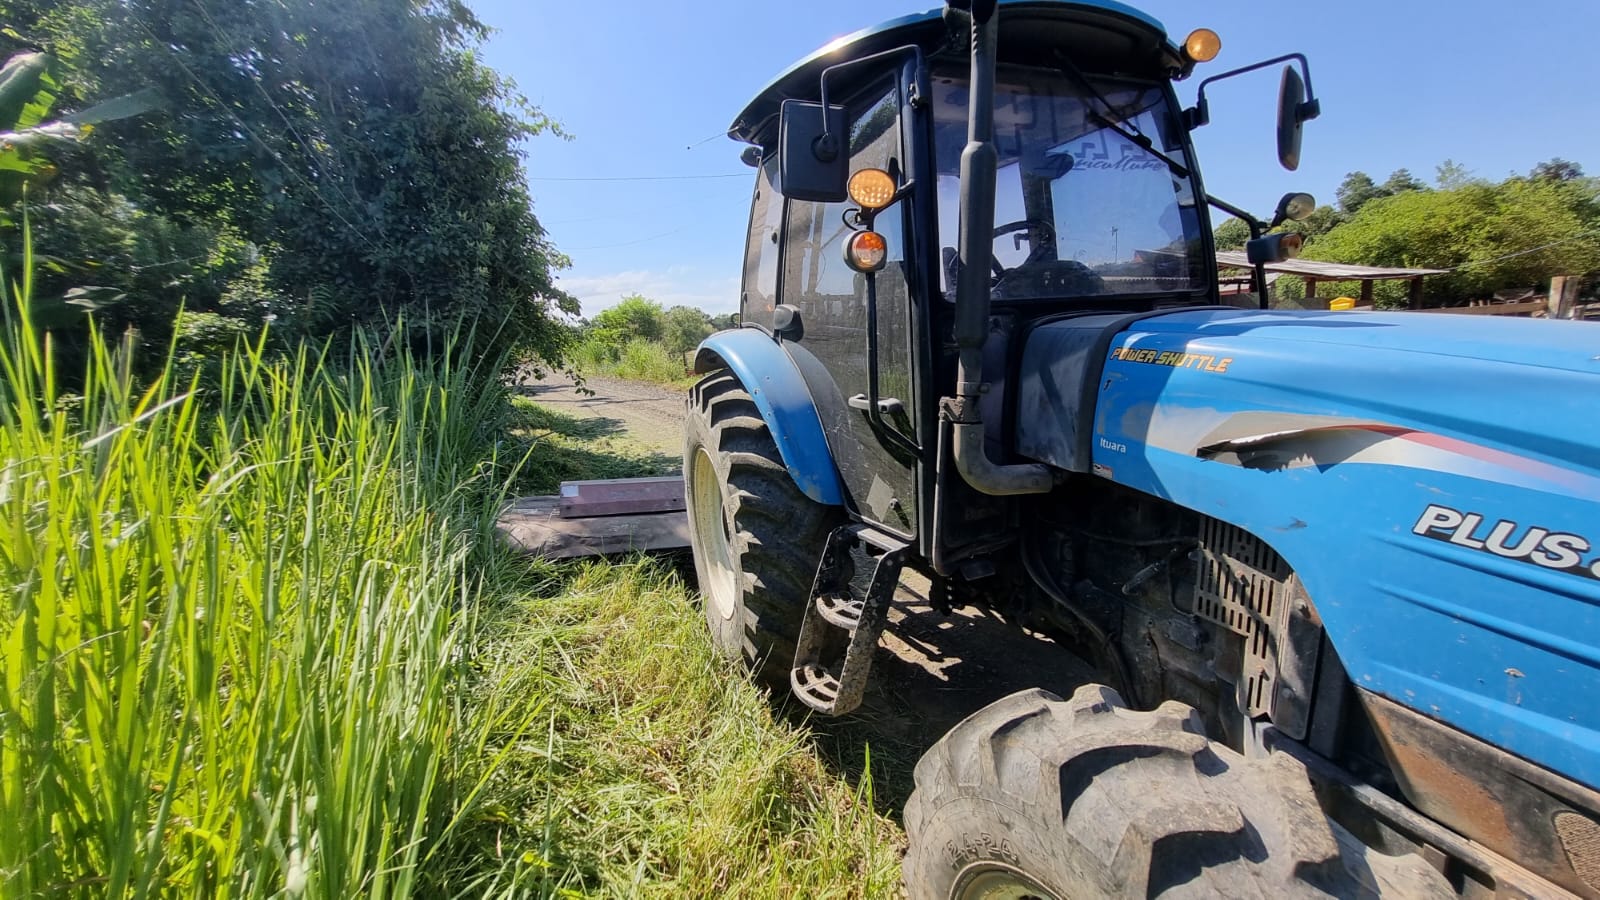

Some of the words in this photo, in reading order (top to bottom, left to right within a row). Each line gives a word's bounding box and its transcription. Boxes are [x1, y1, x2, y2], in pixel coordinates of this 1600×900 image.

[1111, 347, 1157, 364] POWER
[1155, 351, 1233, 373] SHUTTLE
[1100, 437, 1126, 454] Ituara
[1412, 503, 1591, 571] PLUS
